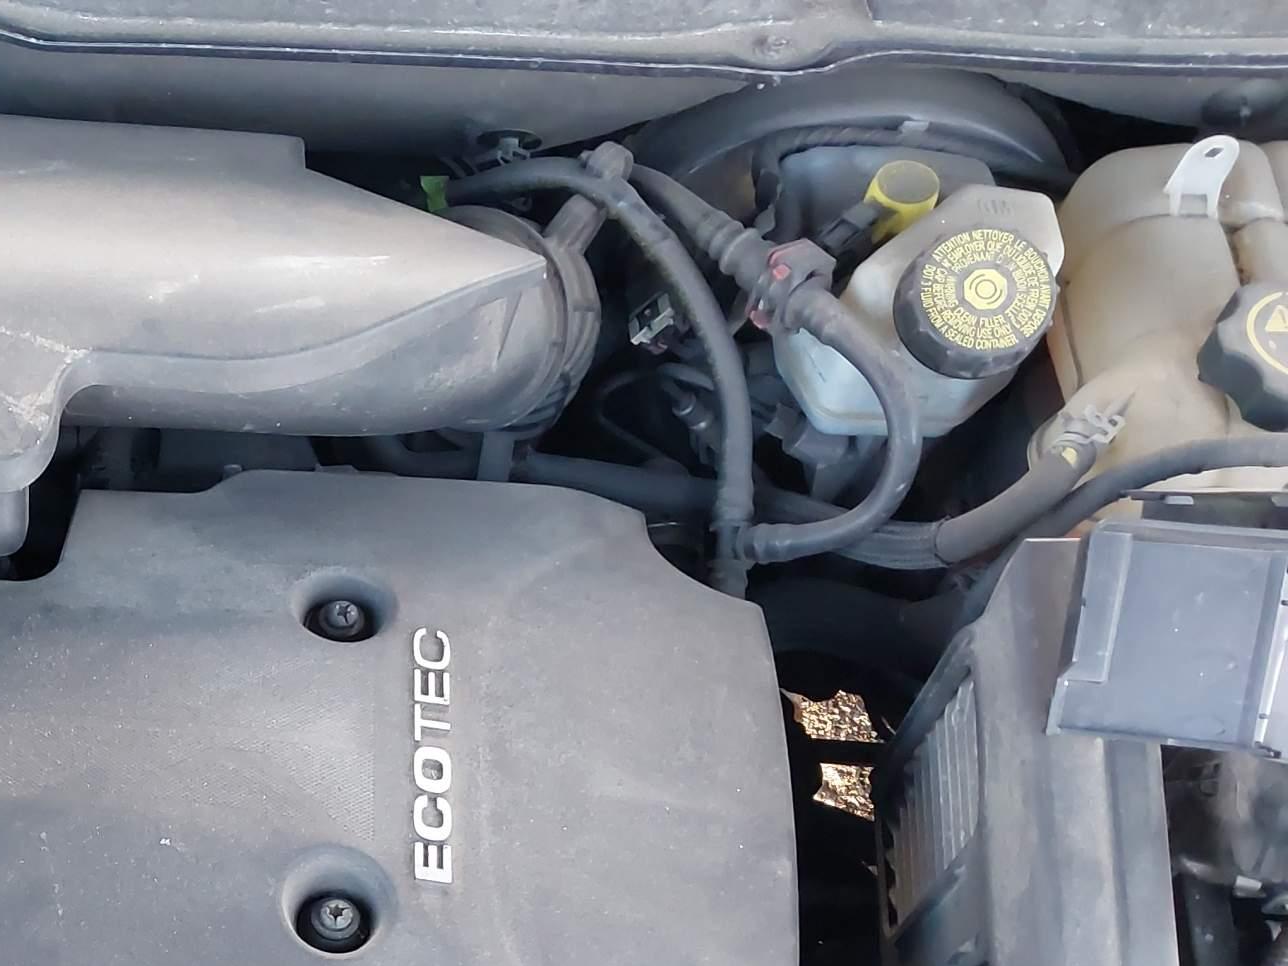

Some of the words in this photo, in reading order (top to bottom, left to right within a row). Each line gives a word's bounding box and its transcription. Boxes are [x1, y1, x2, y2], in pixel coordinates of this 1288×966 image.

[922, 263, 937, 279] DOT
[932, 232, 970, 261] ATTENTION
[971, 229, 1014, 243] NETTOYER
[1014, 239, 1027, 249] LE
[1024, 248, 1049, 282] BOUCHON
[1040, 284, 1052, 309] AVANT
[934, 266, 948, 282] CAP
[987, 241, 1002, 252] QUE
[1016, 309, 1033, 324] DOT
[920, 287, 934, 308] FLUID
[933, 283, 948, 311] BEFORE
[924, 306, 945, 329] FROM
[940, 308, 975, 337] REMOVING
[953, 307, 977, 325] CLEAN
[979, 315, 1006, 326] FILLER
[943, 327, 974, 348] SEALED
[975, 328, 992, 338] USE
[993, 323, 1013, 337] ONLY
[413, 627, 452, 884] ECOTEC
